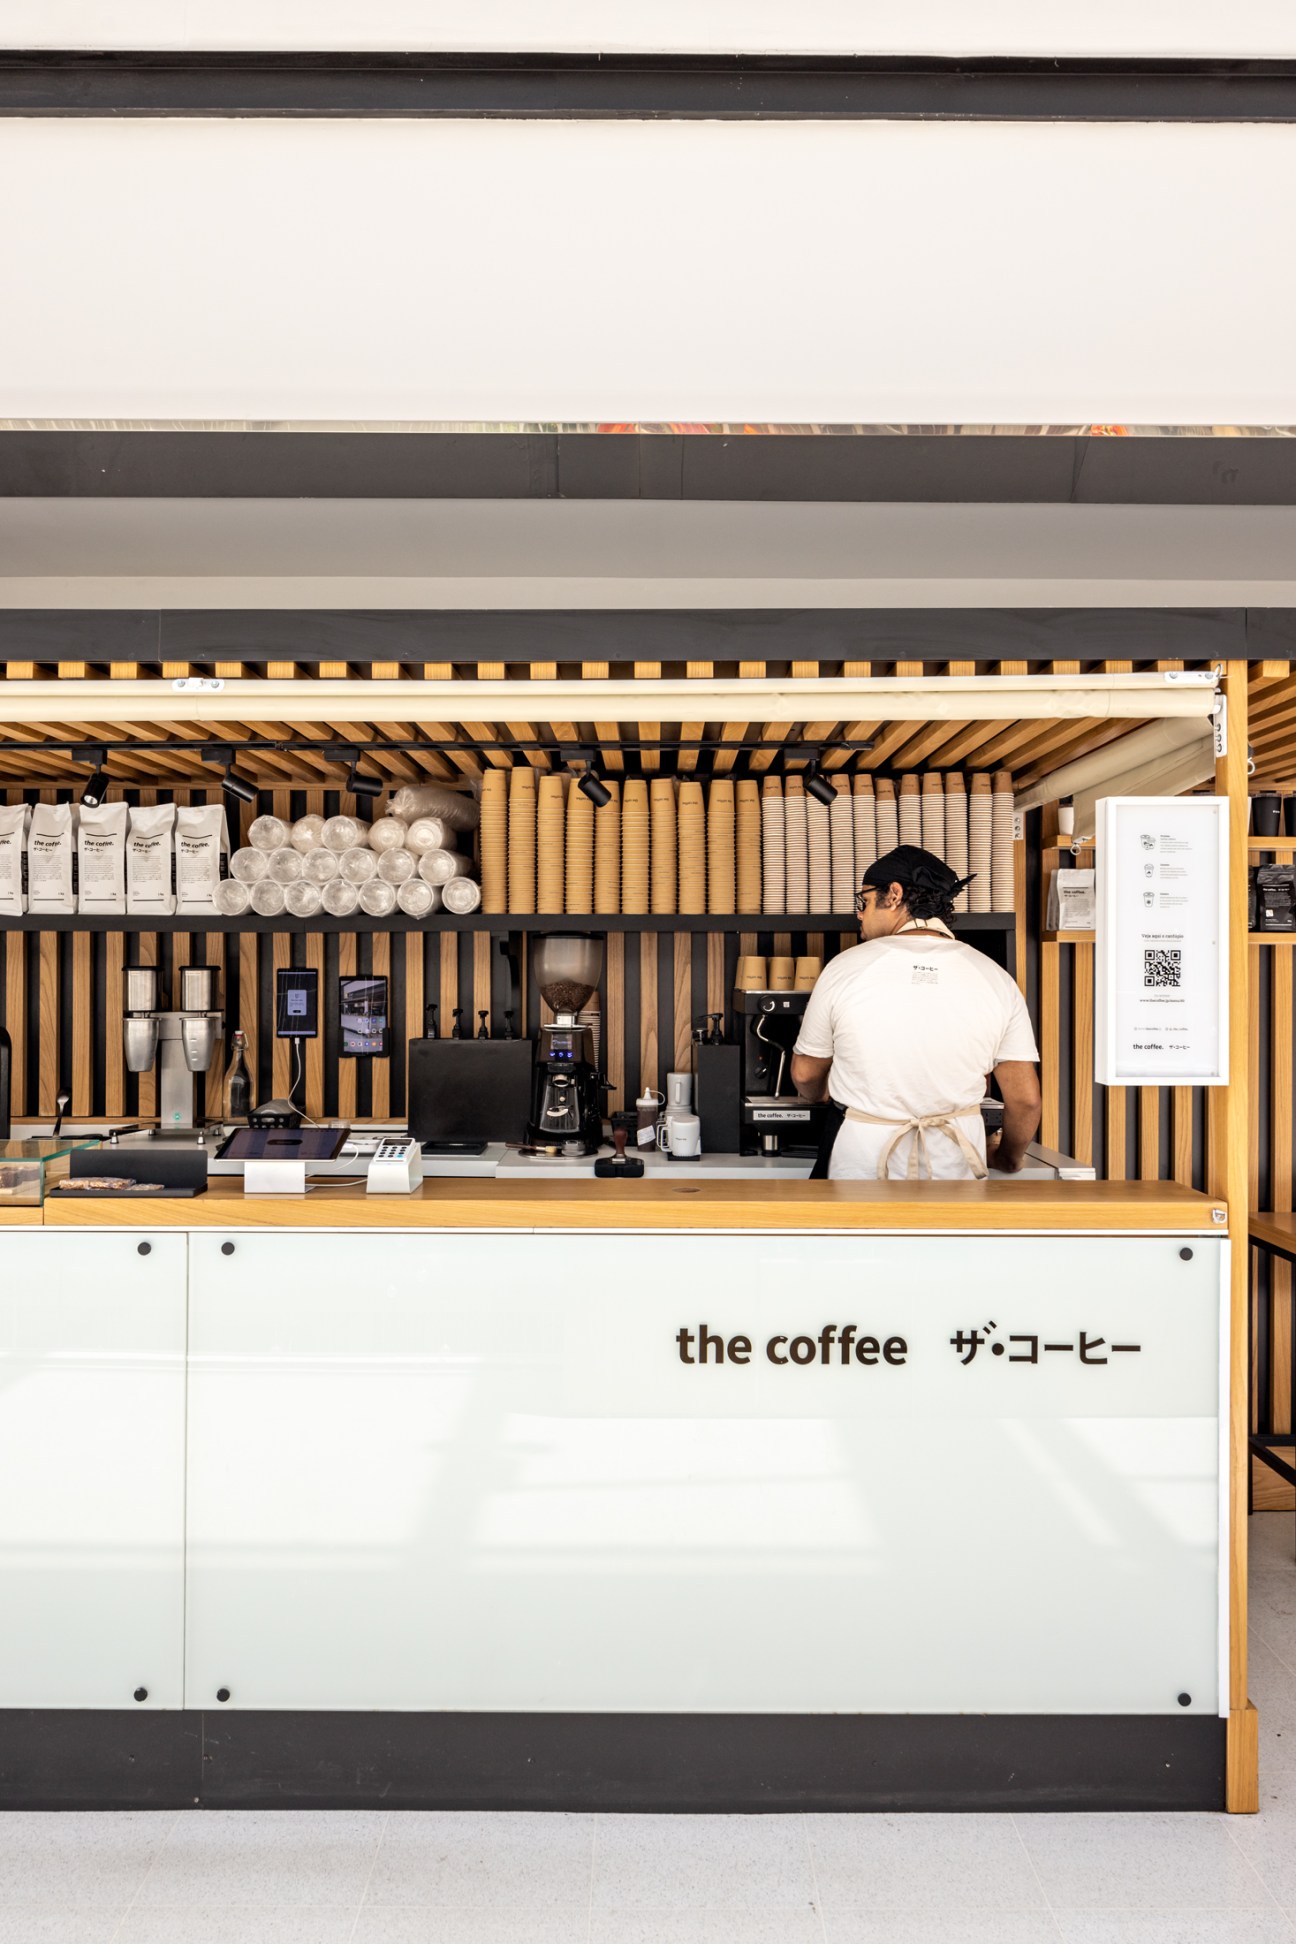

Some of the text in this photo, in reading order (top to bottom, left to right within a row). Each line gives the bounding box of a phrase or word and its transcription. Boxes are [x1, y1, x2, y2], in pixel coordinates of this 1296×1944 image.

[676, 1320, 1142, 1365] the coffee ザ・コーヒー
